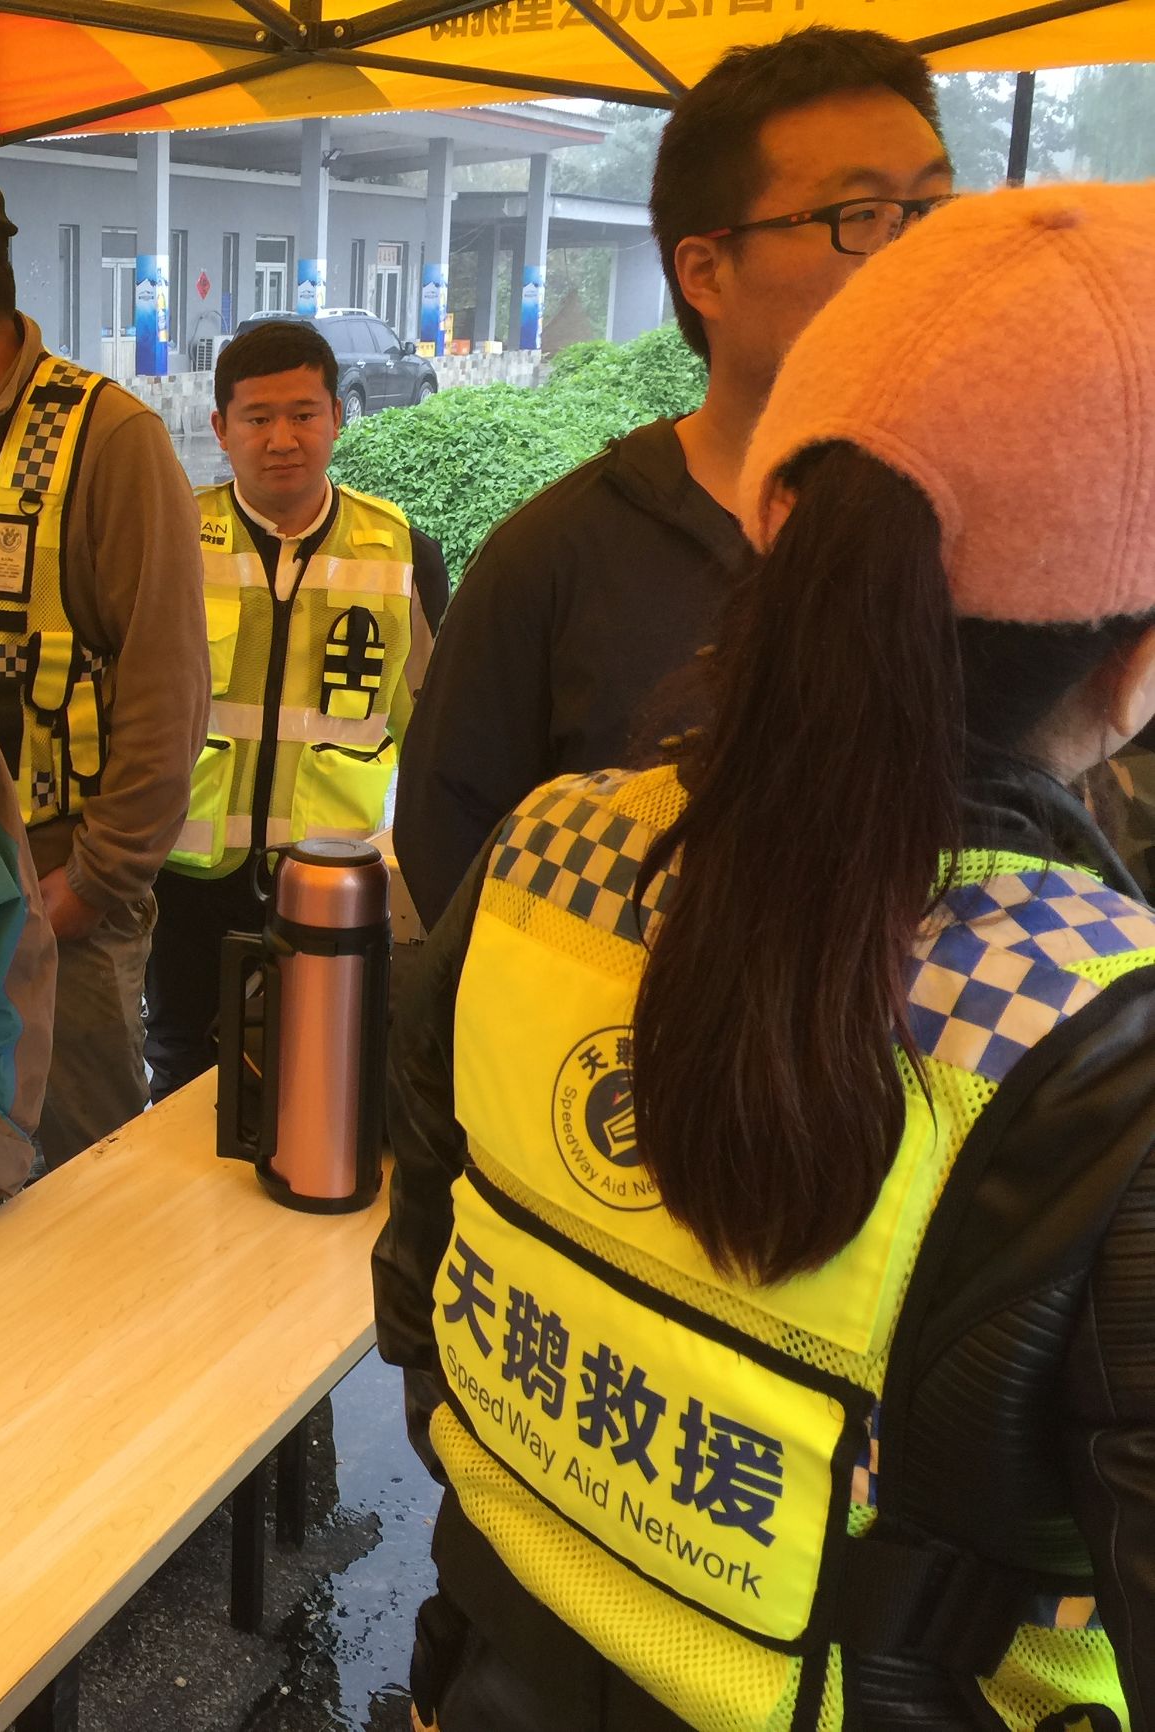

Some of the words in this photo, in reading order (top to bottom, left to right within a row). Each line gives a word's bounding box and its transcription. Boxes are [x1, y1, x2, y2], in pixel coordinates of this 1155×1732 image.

[560, 1085, 599, 1181] SpeedWay
[601, 1175, 627, 1197] Aid
[442, 1234, 785, 1548] 天鹅救援
[446, 1343, 557, 1474] SpeedWay
[562, 1457, 609, 1511] Aid
[619, 1491, 764, 1600] Network
